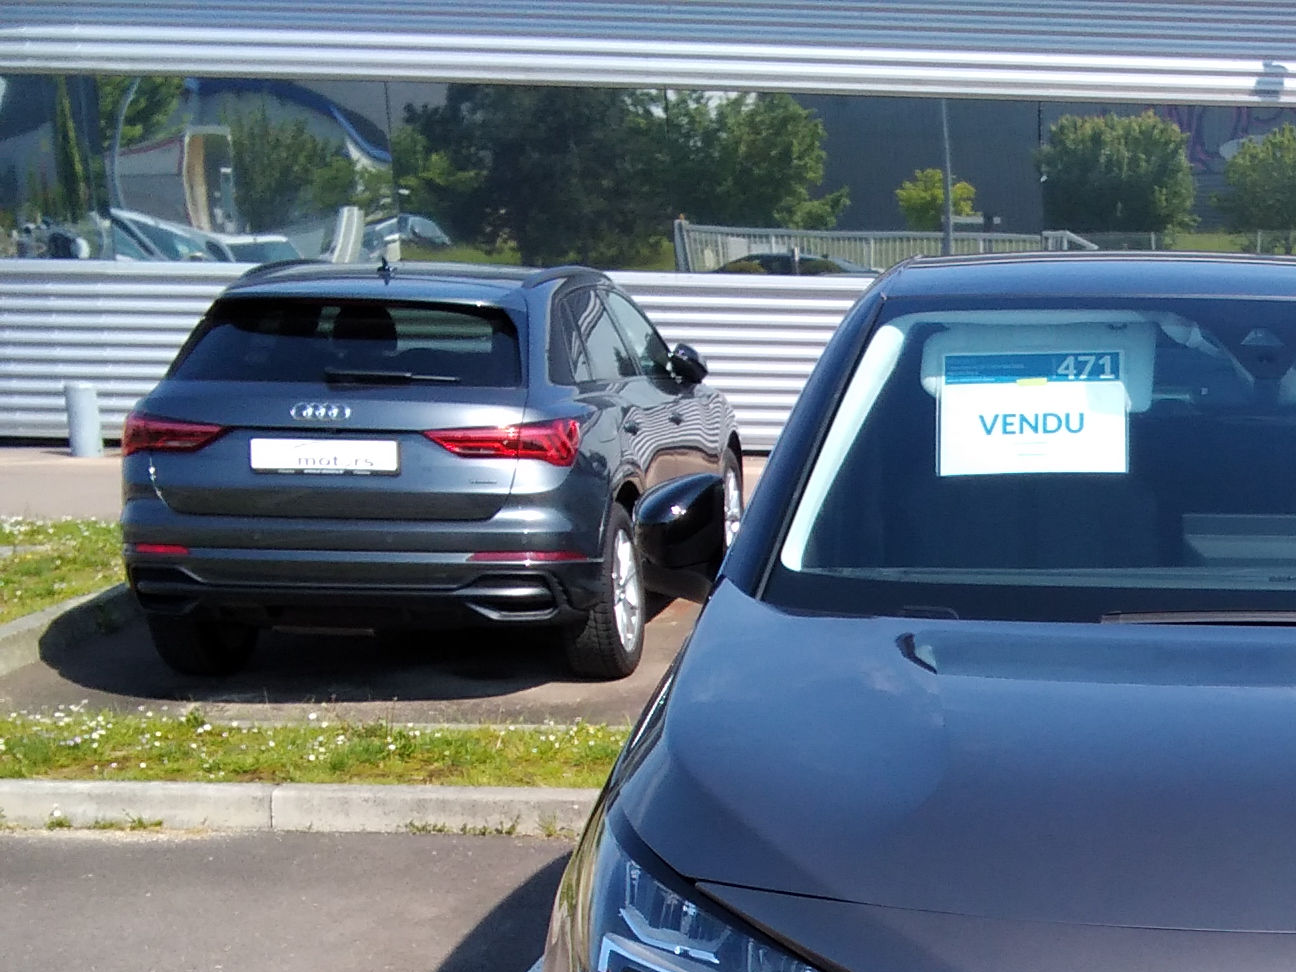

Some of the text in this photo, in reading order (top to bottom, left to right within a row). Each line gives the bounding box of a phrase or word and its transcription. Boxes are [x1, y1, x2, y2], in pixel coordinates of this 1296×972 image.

[1057, 355, 1116, 379] 471
[978, 412, 1085, 436] VENDU
[298, 455, 375, 467] motrs
